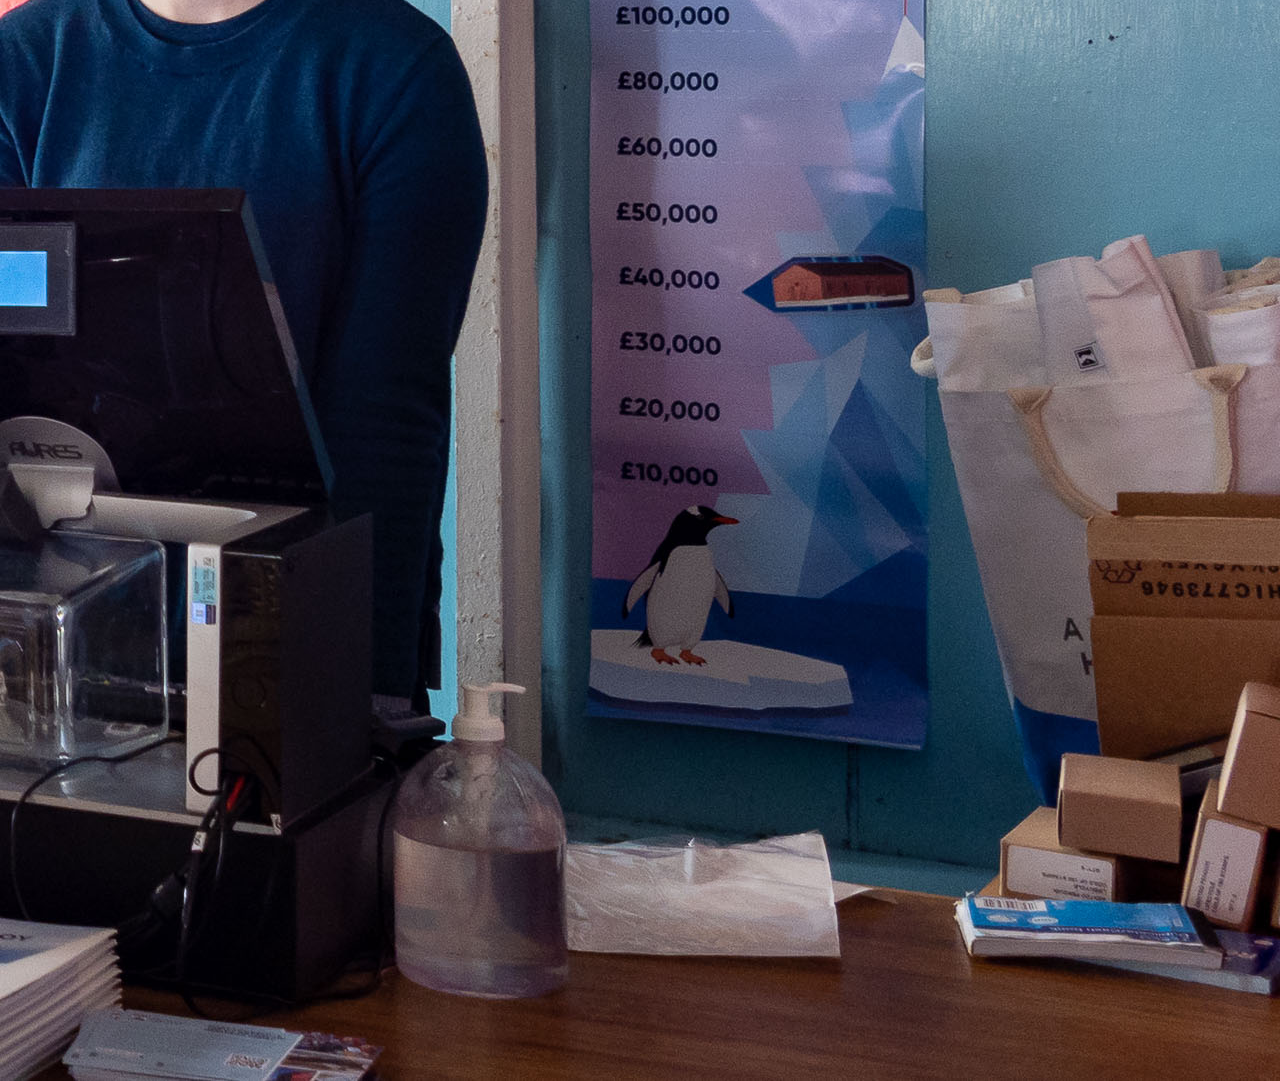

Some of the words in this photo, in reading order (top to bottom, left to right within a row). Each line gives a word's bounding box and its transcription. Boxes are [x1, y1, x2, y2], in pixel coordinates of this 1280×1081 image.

[616, 6, 730, 28] £100,000
[617, 71, 719, 94] £80,000
[617, 137, 718, 160] £60,000
[617, 202, 718, 225] £50,000
[619, 266, 720, 291] £40,000
[619, 331, 721, 356] £30,000
[619, 396, 720, 422] £20,000
[7, 441, 83, 460] AURES
[620, 461, 719, 486] £10,000
